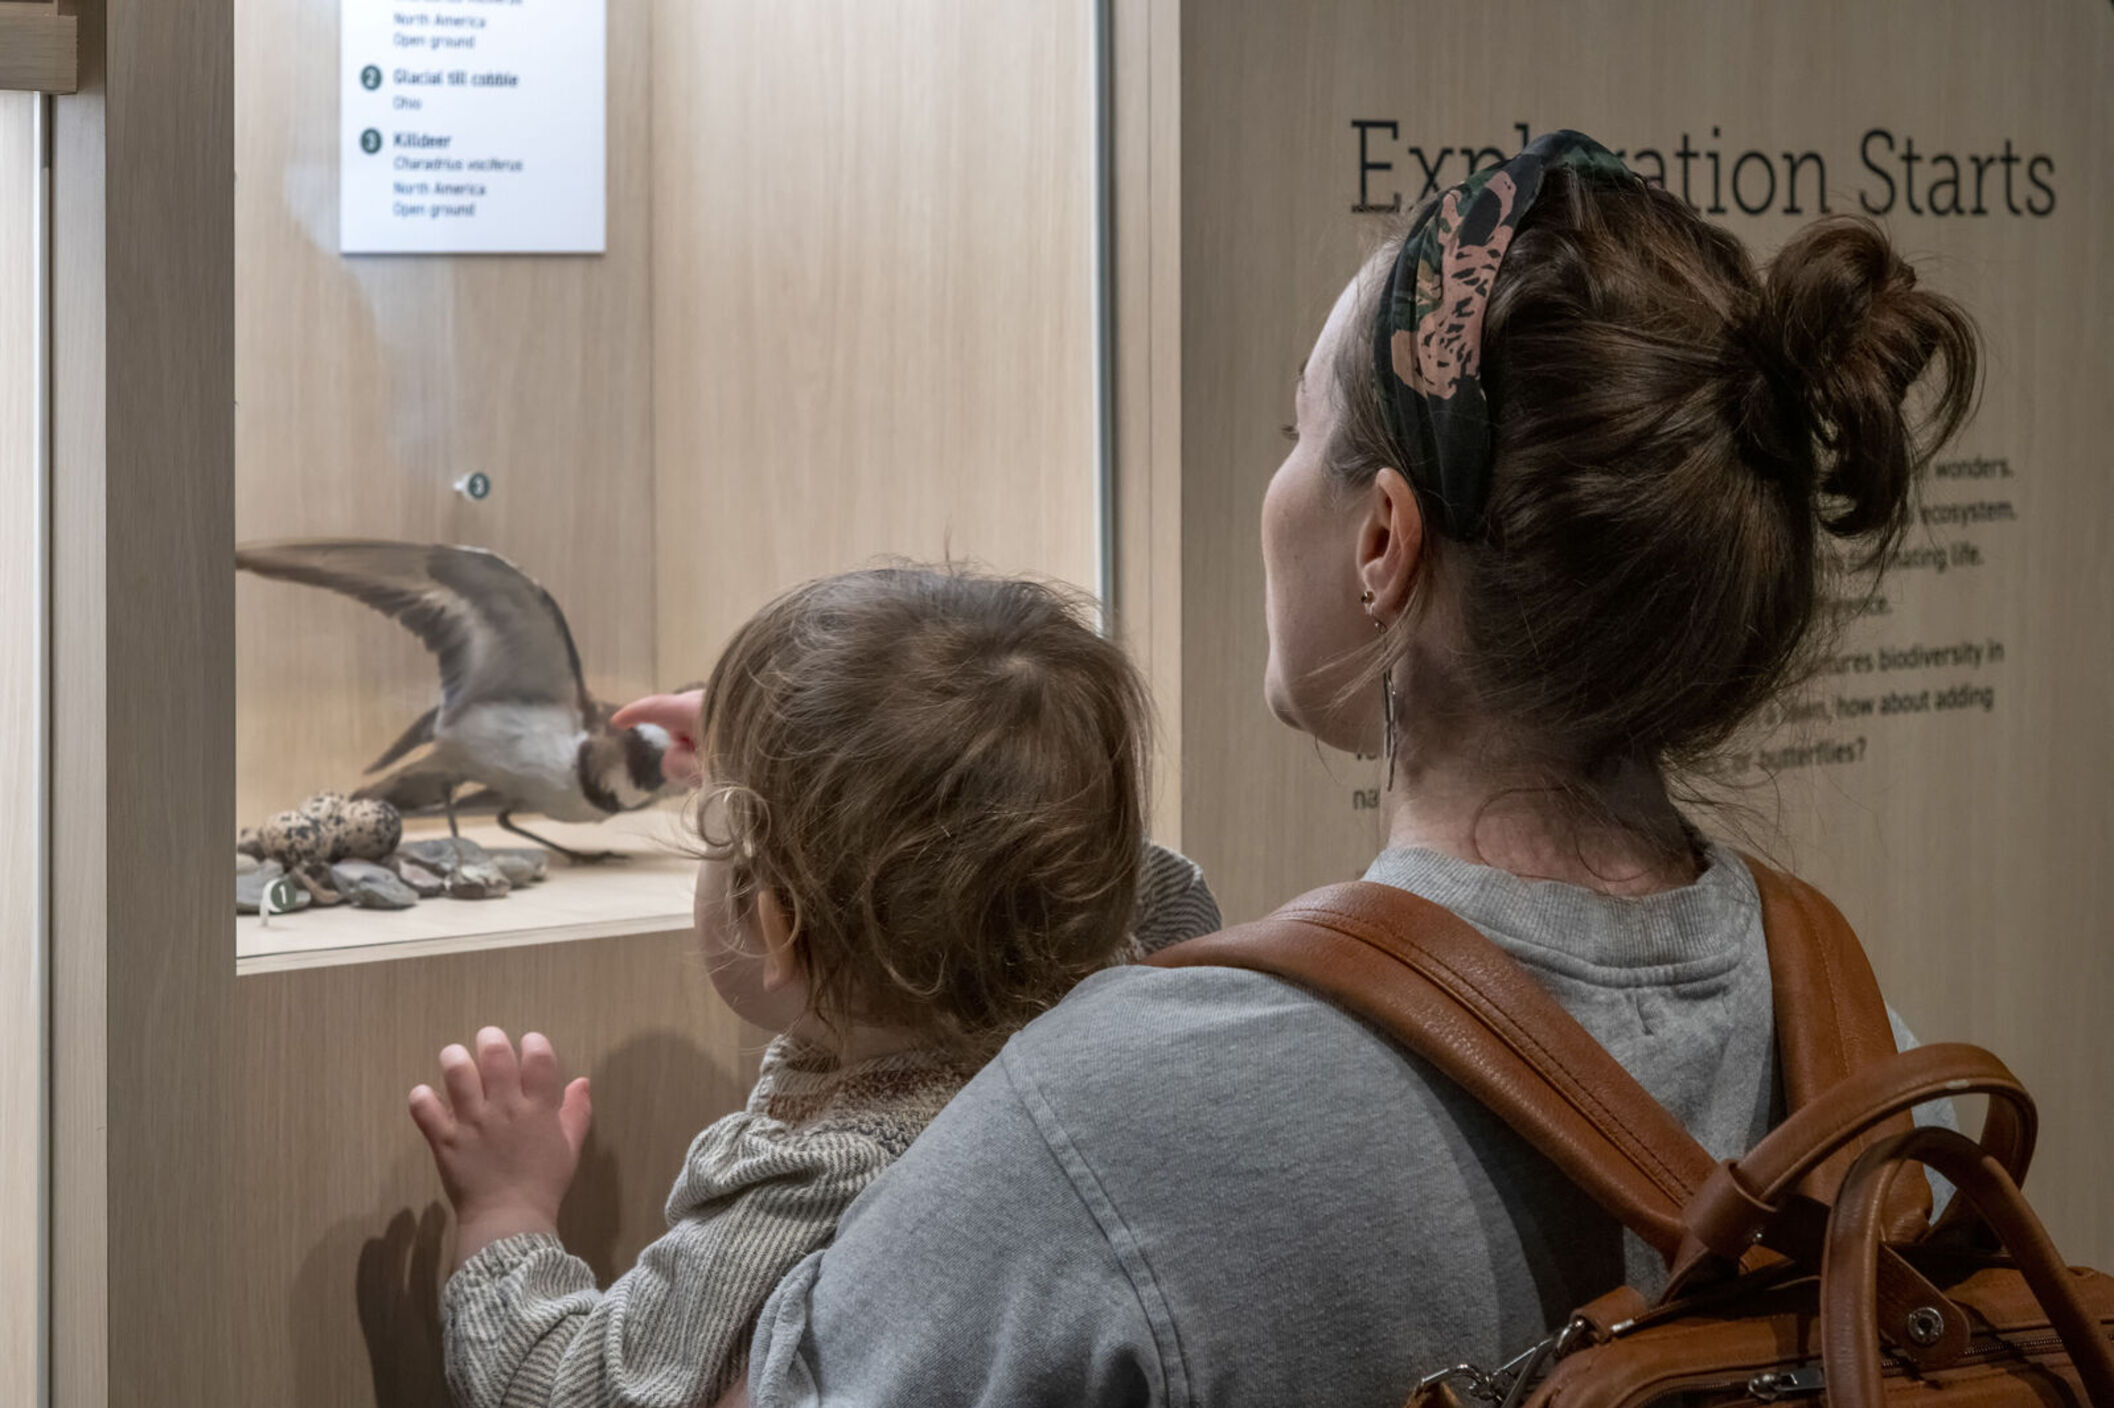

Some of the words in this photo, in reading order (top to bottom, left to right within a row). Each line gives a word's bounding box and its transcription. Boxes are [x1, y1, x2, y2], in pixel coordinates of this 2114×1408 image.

[393, 13, 428, 27] North
[434, 14, 486, 28] America
[393, 33, 425, 48] Open
[430, 35, 475, 49] ground
[393, 69, 442, 86] Glacial
[447, 70, 466, 85] till
[471, 71, 518, 88] cobble
[393, 96, 421, 110] Ohio
[393, 132, 451, 149] Killdeer
[1859, 129, 2056, 218] Starts
[393, 182, 428, 196] North
[434, 182, 486, 197] America
[393, 202, 425, 217] Open
[430, 204, 475, 219] ground
[1878, 642, 1983, 672] biodiversity
[1986, 638, 2005, 664] in
[1836, 696, 1875, 718] how
[1879, 692, 1929, 716] about
[1934, 684, 1994, 713] adding
